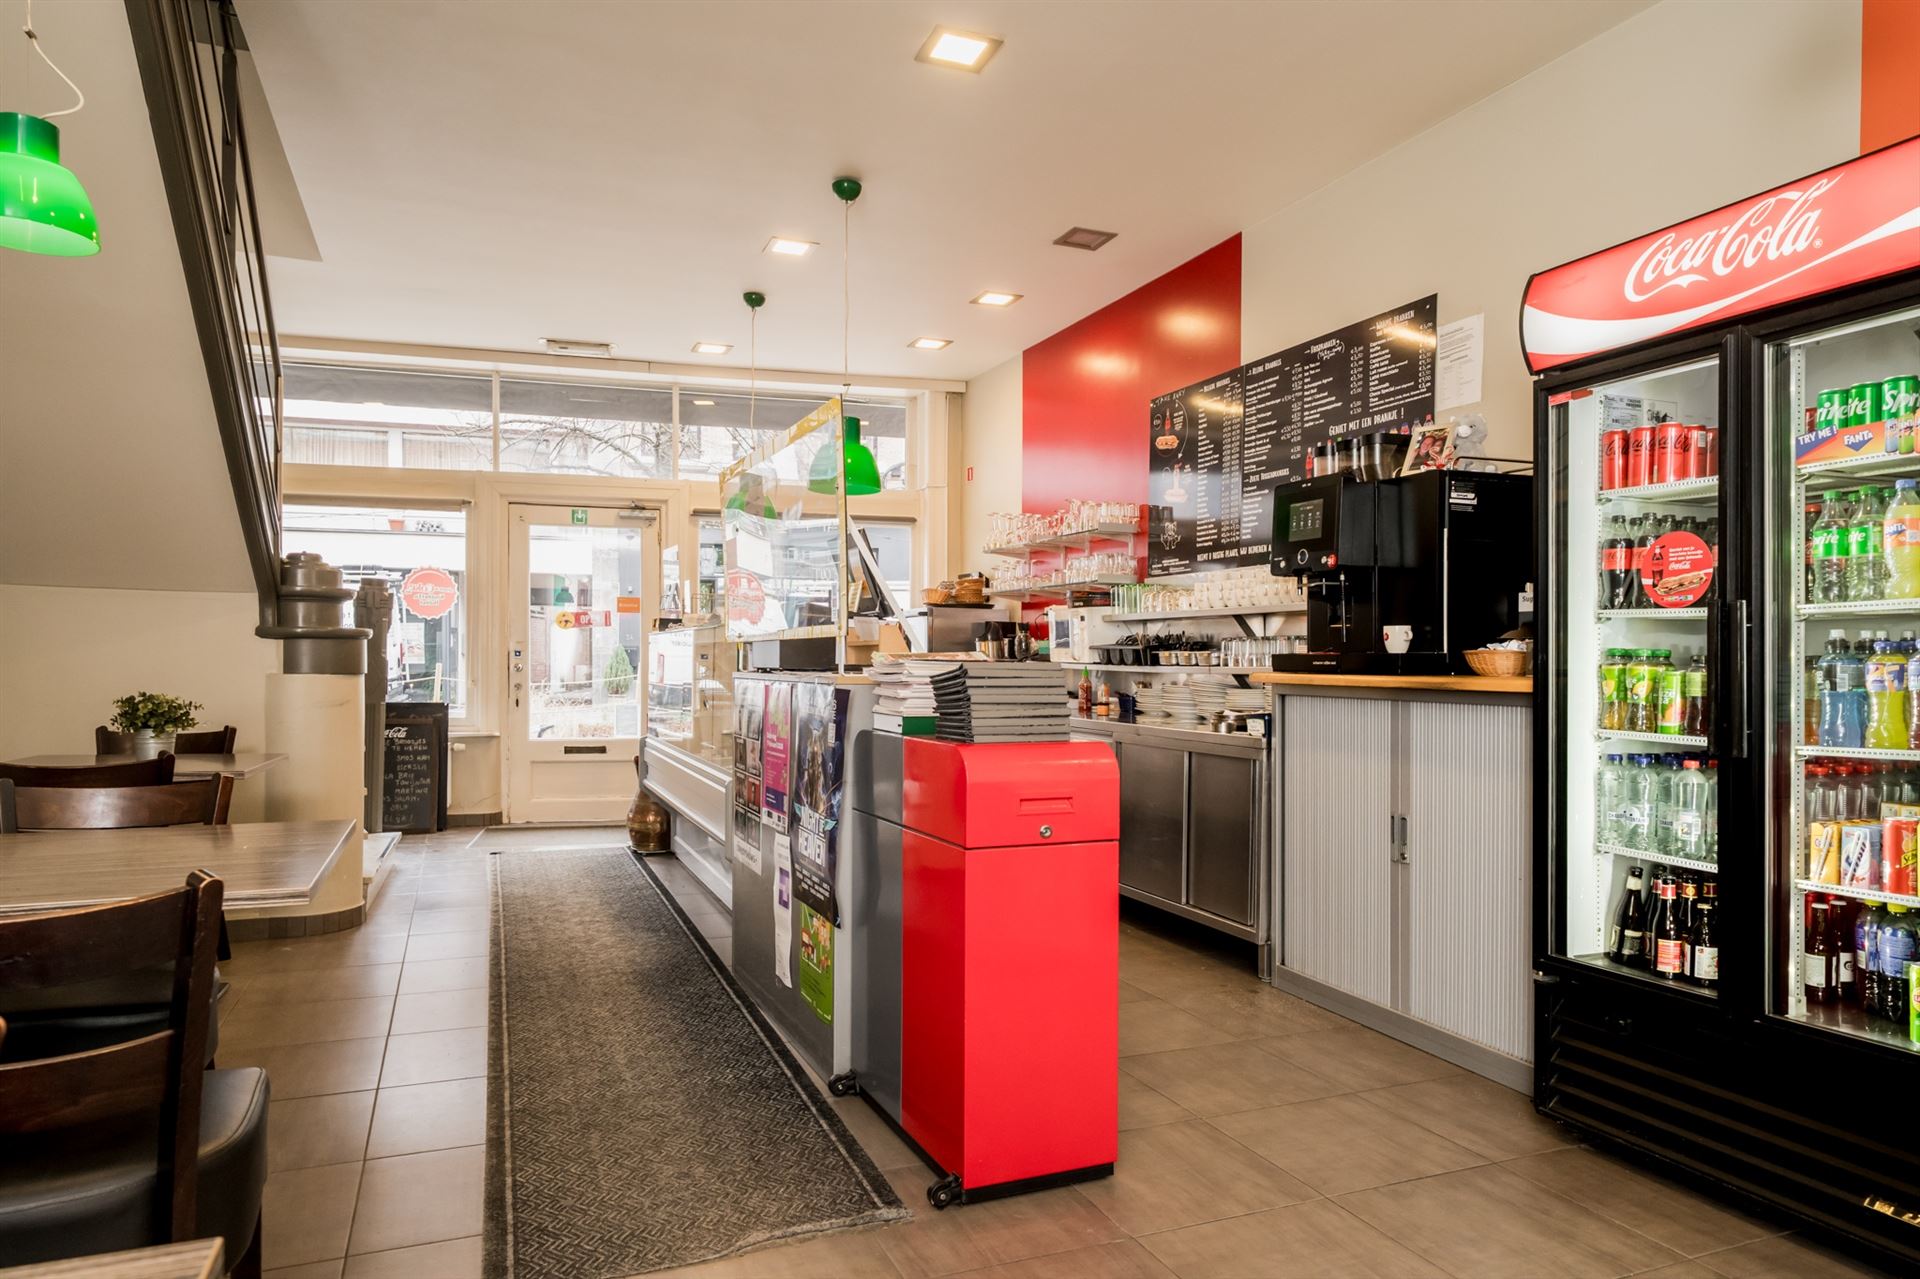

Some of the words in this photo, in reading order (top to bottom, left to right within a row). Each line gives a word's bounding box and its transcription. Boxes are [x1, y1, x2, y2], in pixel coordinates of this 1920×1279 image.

[1624, 171, 1846, 302] Coca-Cola
[1348, 419, 1360, 431] MET
[1361, 417, 1372, 428] EEN
[1374, 409, 1398, 425] DRANKJE
[1798, 431, 1817, 445] TRY
[1817, 427, 1832, 439] ME
[1844, 430, 1873, 445] FANTA
[798, 825, 826, 868] HEAVEN
